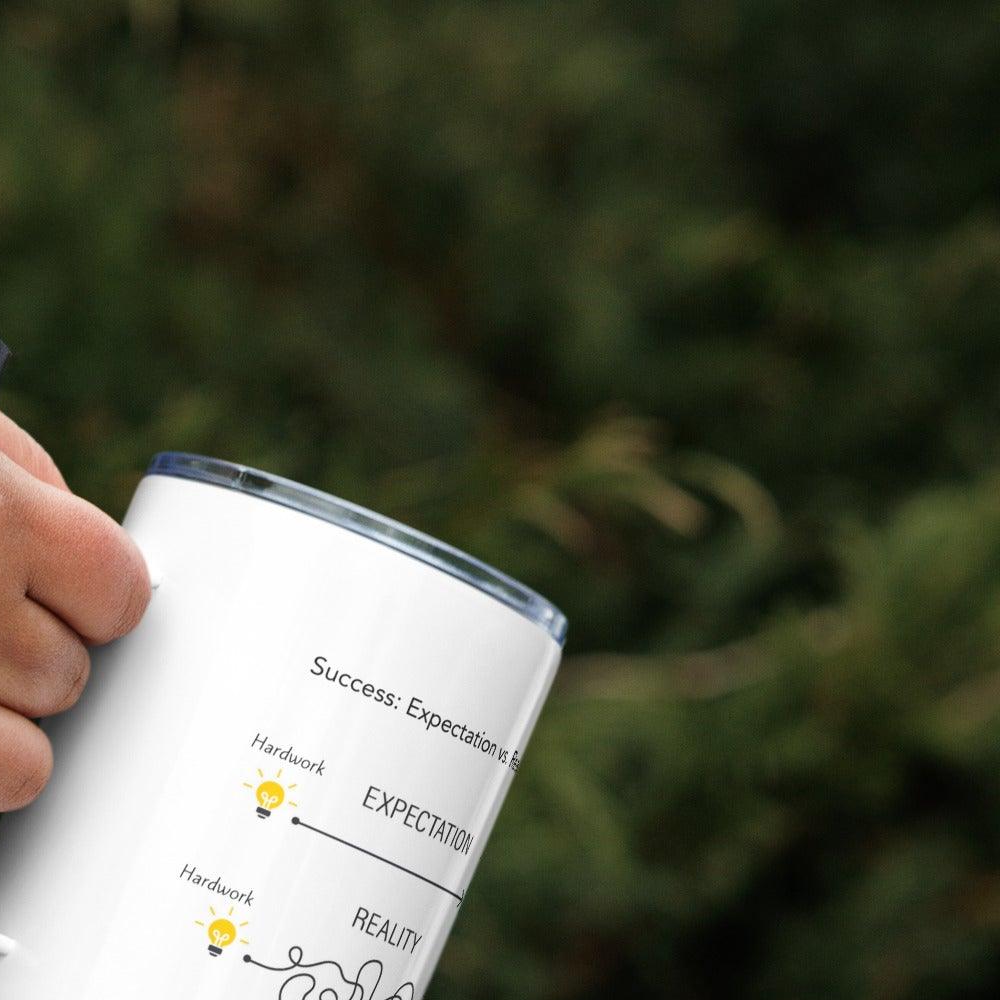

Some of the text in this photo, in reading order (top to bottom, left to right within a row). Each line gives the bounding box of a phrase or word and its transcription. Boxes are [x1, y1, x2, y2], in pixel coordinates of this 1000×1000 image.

[310, 656, 402, 709] Success:
[406, 697, 497, 757] Expectation
[250, 733, 327, 776] Hardwork
[362, 785, 474, 855] EXPECTATION
[179, 864, 255, 906] Hardwork
[352, 907, 422, 954] REALITY
